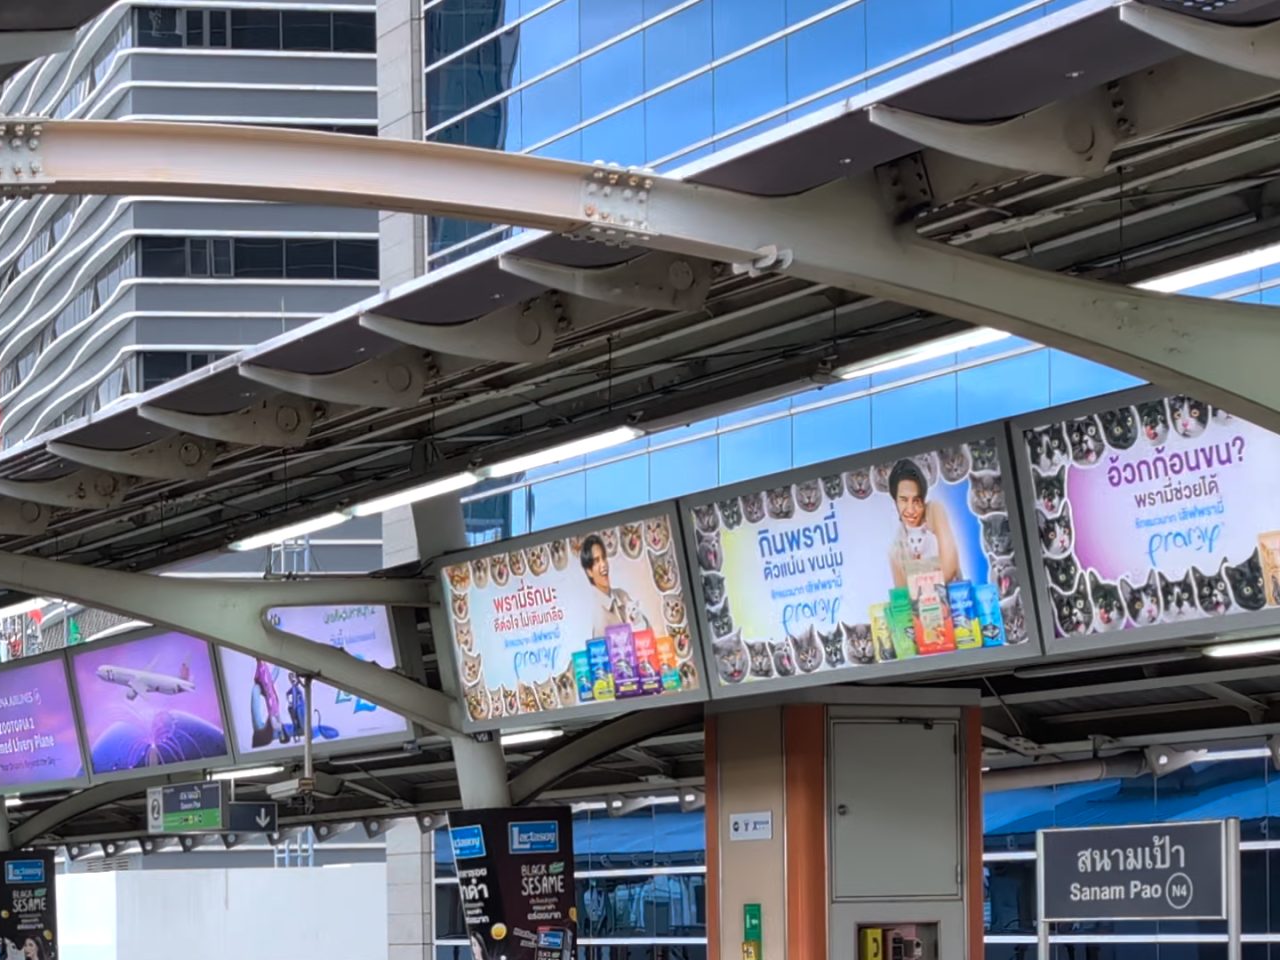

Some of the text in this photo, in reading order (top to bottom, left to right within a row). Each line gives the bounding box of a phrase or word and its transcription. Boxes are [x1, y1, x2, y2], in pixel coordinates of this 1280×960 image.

[1106, 436, 1246, 488] อ้วกก้อนขน?
[1134, 474, 1219, 508] พรามี่ช่วยได้
[757, 504, 840, 558] กินพรามี่
[763, 545, 844, 582] ตัวแน่น ขนนุ่ม
[492, 578, 558, 615] พรามี่รักนะ
[8, 691, 34, 708] AIRLINES
[12, 736, 34, 753] Livery
[33, 734, 56, 749] Plane
[511, 826, 556, 850] Lactasoy
[1077, 835, 1186, 873] สนามเป้า
[521, 864, 547, 876] BLACK
[12, 889, 33, 899] BLACK
[521, 875, 565, 896] SESAME
[1070, 880, 1188, 901] Sanam Pao N4
[12, 897, 47, 913] SESAME
